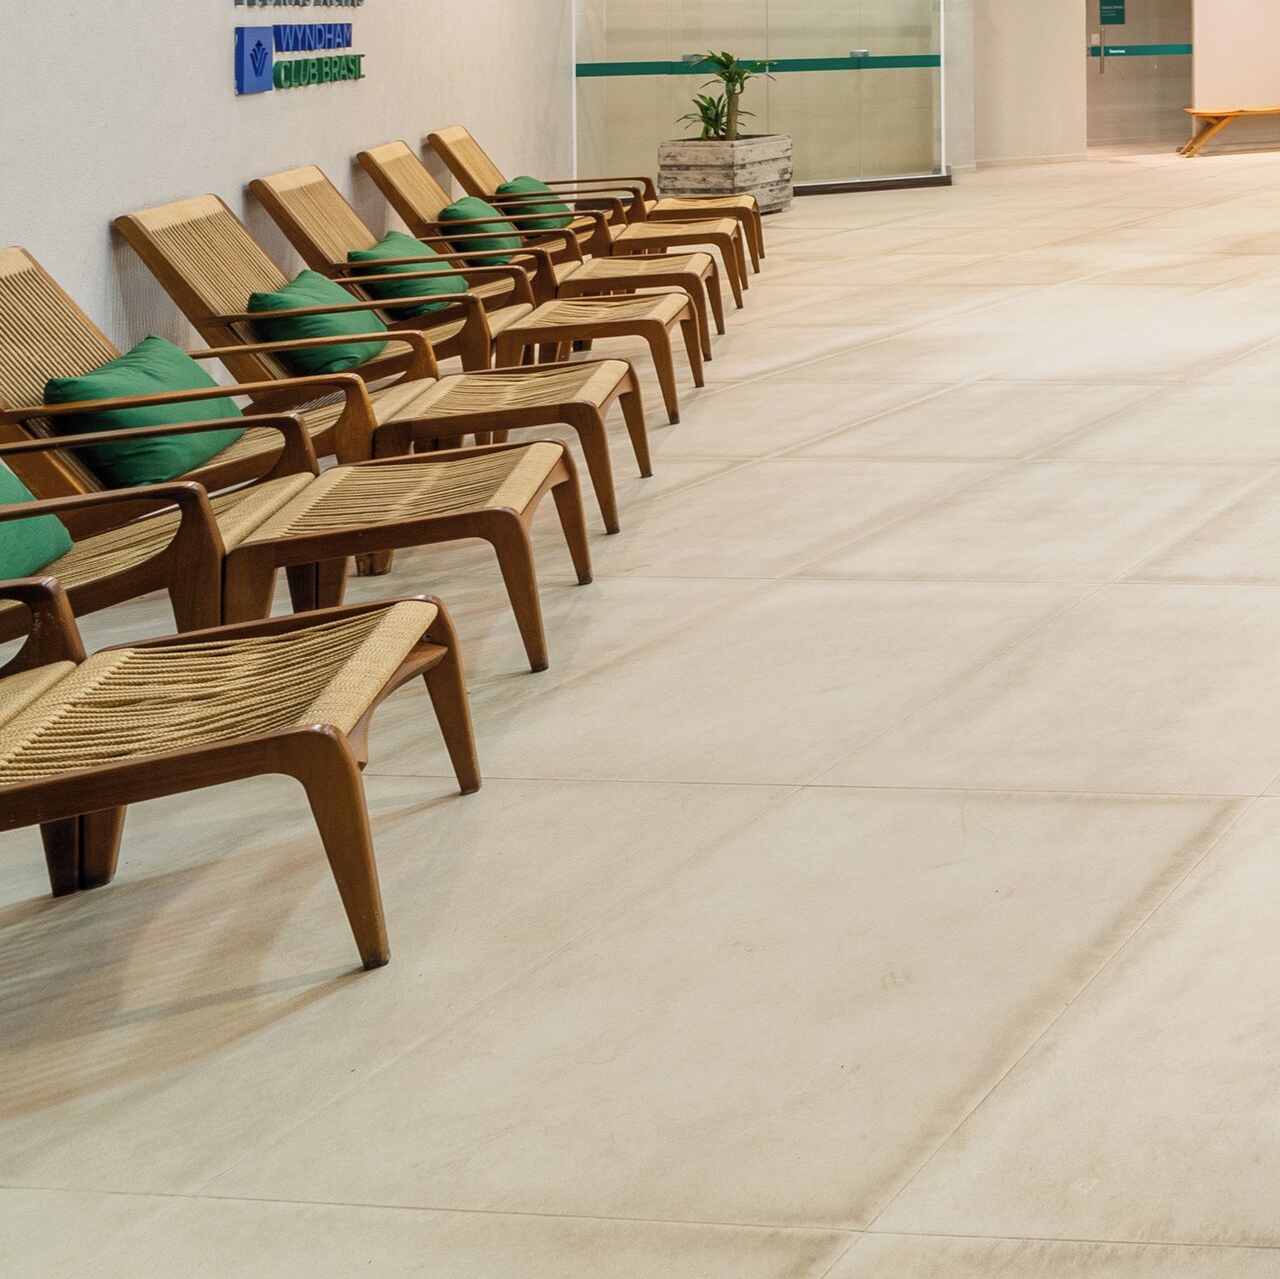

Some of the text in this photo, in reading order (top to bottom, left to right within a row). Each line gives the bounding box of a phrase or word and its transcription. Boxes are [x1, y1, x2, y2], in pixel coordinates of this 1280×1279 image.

[272, 23, 352, 52] WYNDHAM
[272, 54, 365, 89] CLUB BRASIL
